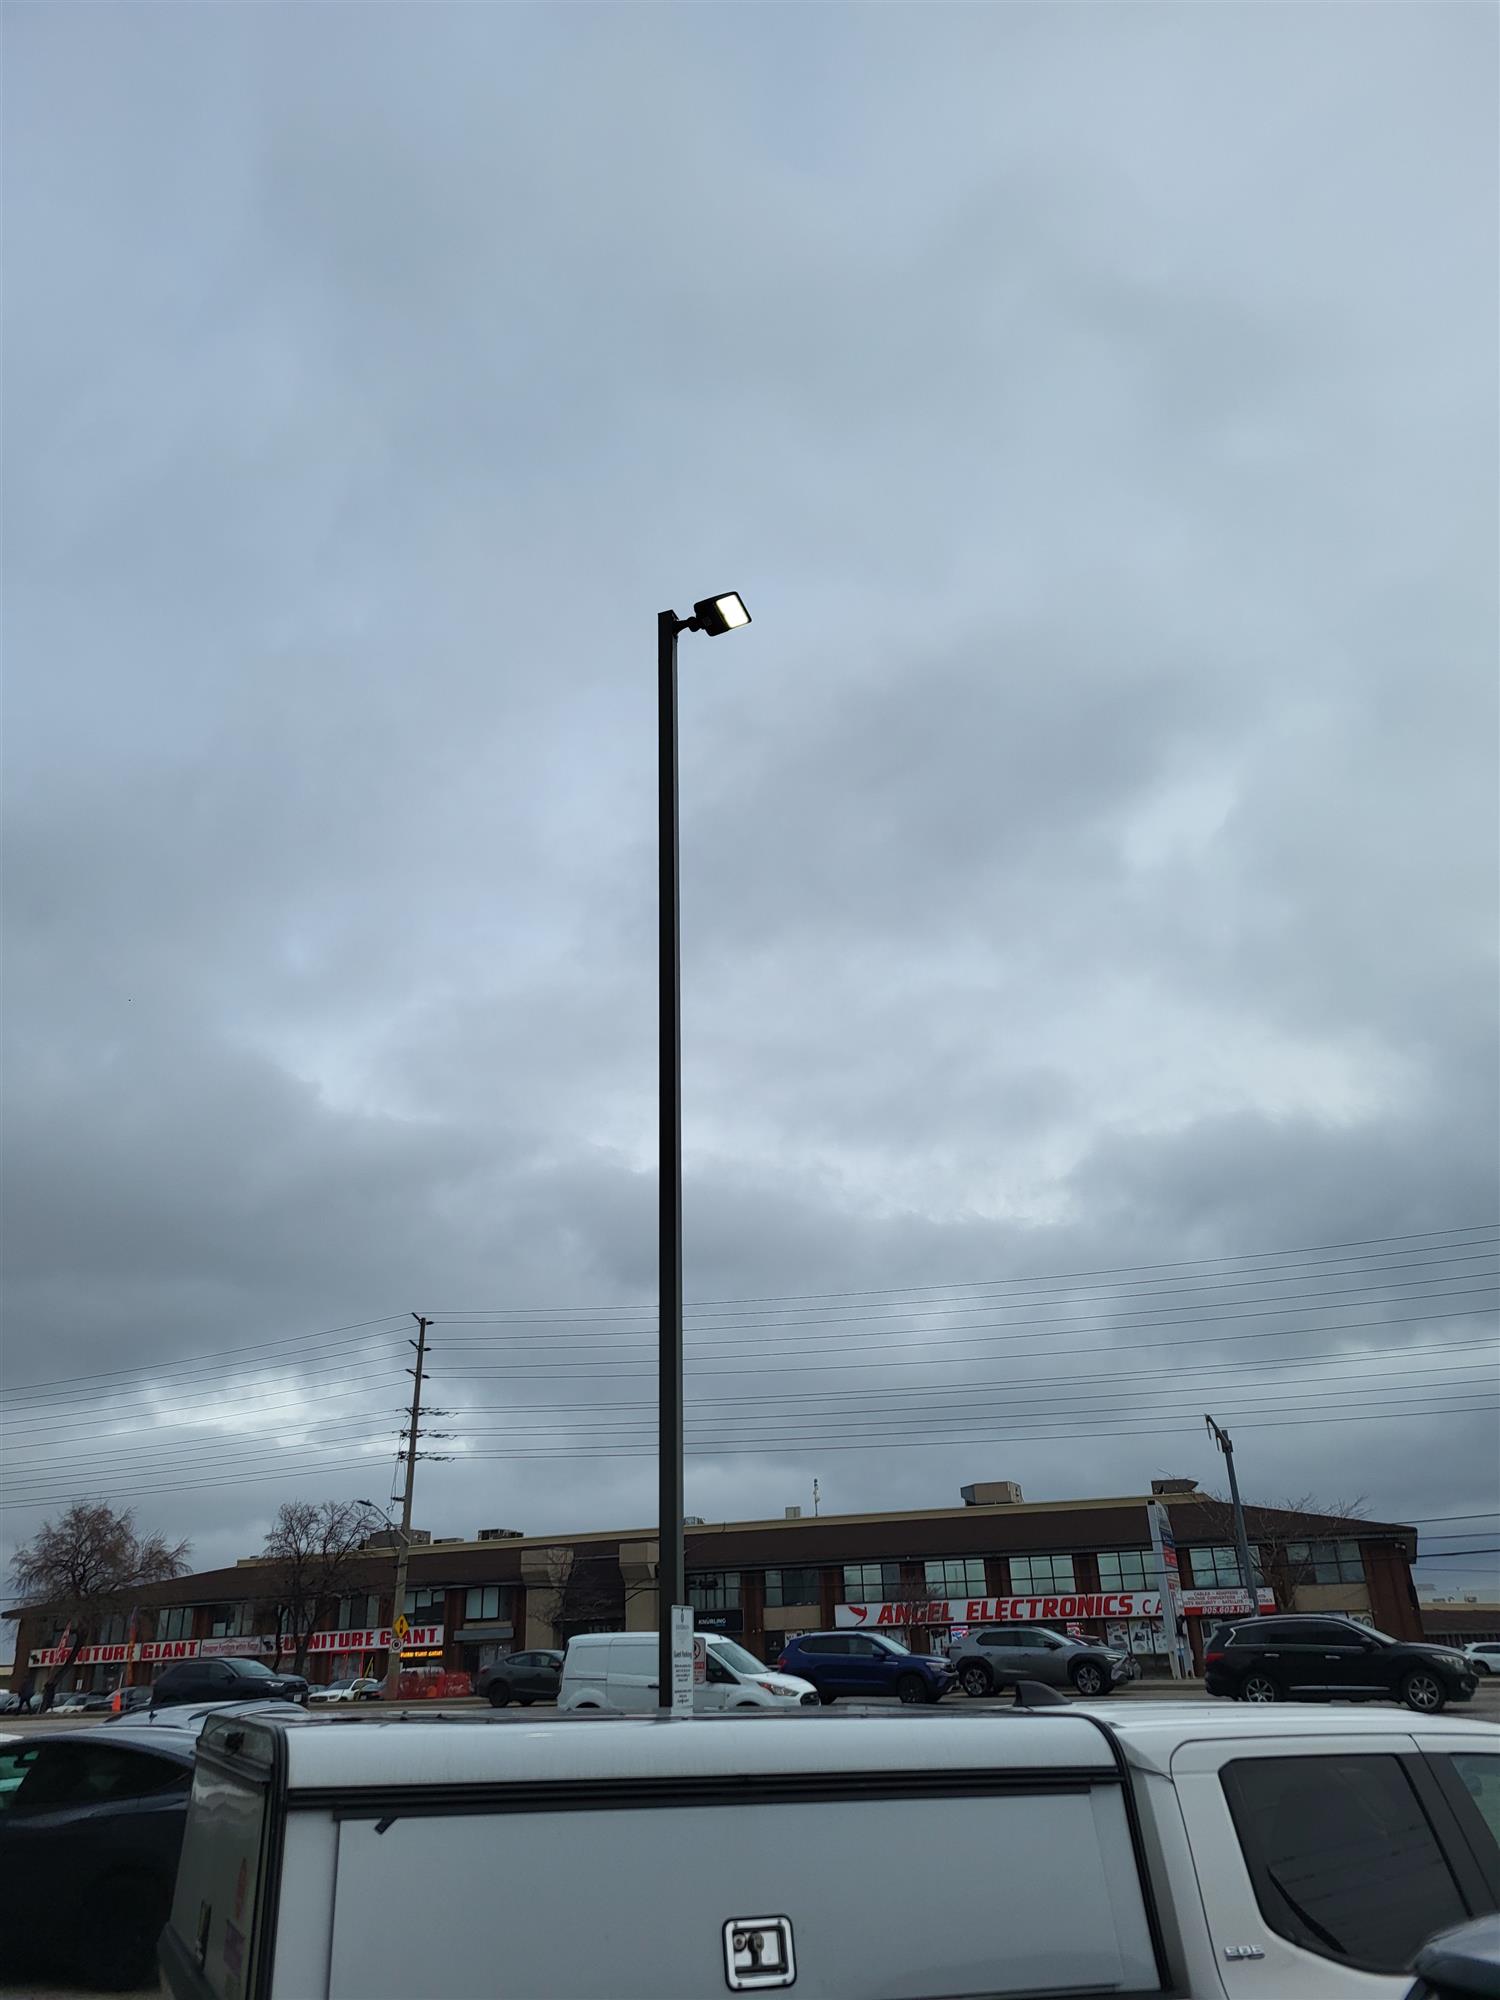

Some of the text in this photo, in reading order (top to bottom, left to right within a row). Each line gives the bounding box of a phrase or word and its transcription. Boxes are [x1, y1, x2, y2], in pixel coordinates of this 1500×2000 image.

[877, 1602, 954, 1624] ANGEL
[1202, 1605, 1250, 1614] 905.602.138
[380, 1628, 438, 1649] GANT
[141, 1641, 198, 1659] GIANT
